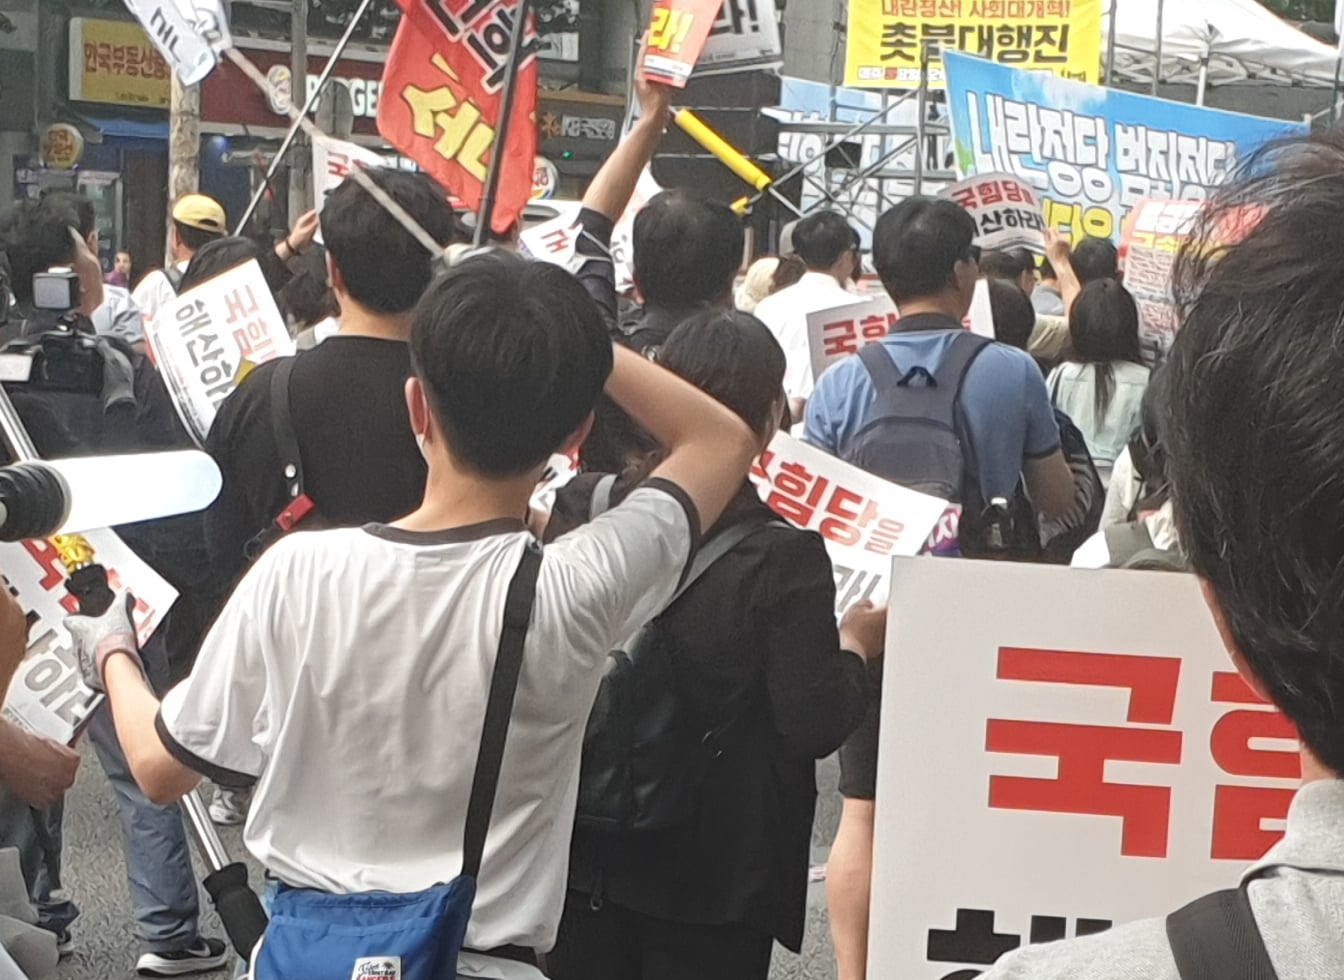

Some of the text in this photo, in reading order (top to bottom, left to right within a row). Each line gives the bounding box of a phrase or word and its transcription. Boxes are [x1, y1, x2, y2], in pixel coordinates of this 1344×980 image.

[973, 207, 1047, 237] 산하라!
[175, 299, 235, 411] 해산하
[224, 284, 277, 361] 국힘
